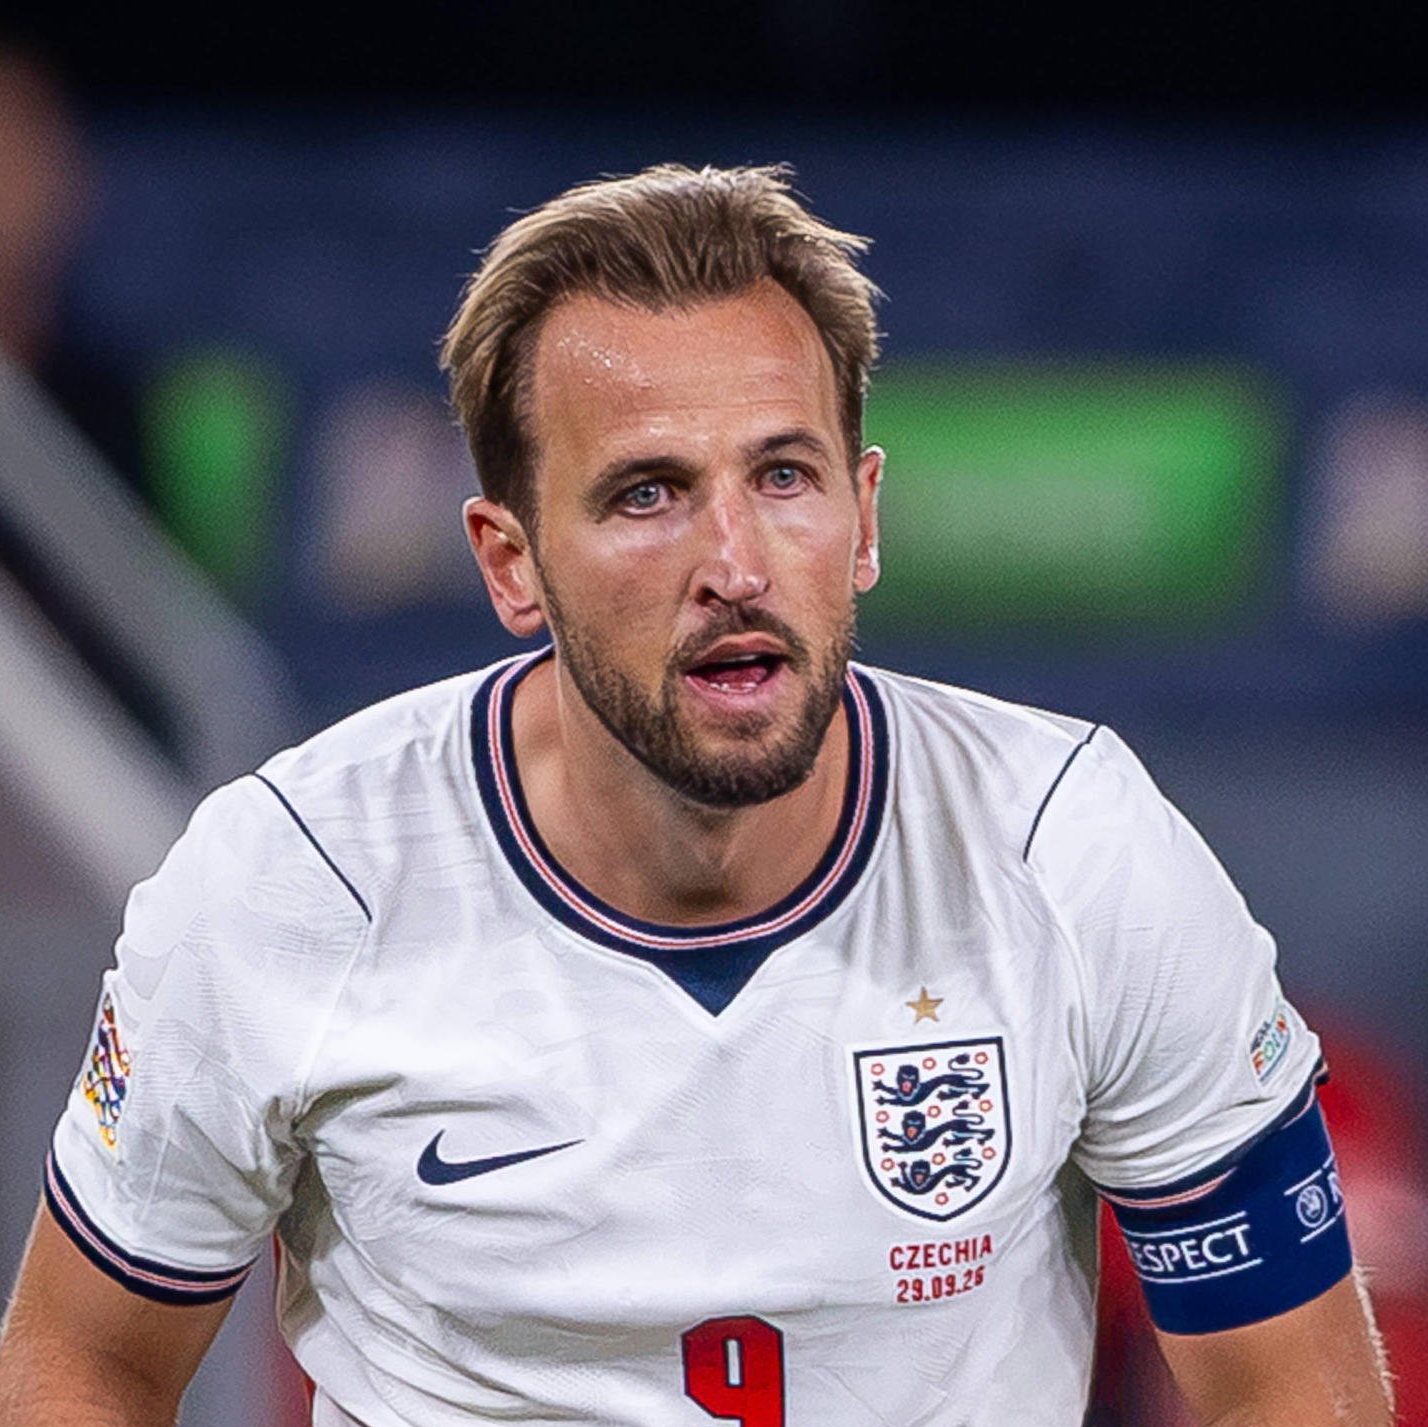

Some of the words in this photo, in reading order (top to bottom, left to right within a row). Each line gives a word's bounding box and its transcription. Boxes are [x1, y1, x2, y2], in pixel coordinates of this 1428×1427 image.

[890, 1234, 992, 1270] CZECHIA
[1130, 1224, 1250, 1272] ESPECT
[897, 1265, 985, 1303] 29.09.26
